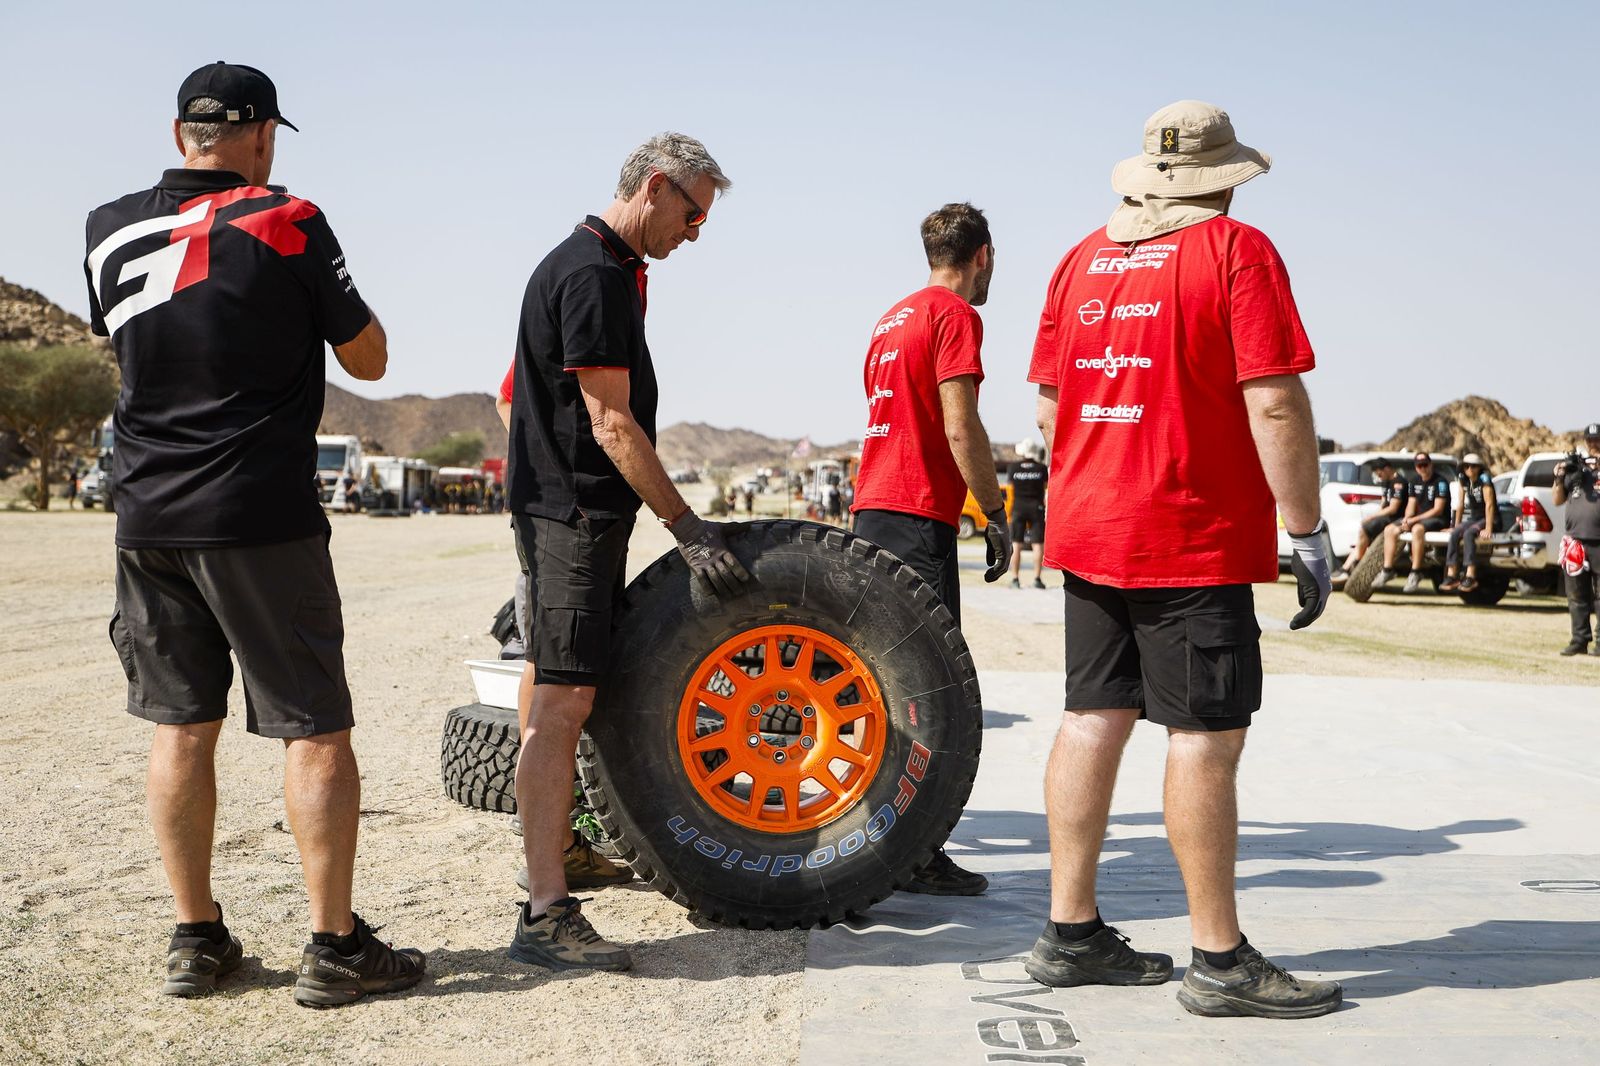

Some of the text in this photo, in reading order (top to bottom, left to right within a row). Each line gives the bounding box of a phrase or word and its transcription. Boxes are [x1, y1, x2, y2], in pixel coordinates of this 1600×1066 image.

[1134, 244, 1178, 254] TOYOTA
[1088, 256, 1128, 273] GR
[1111, 301, 1162, 321] repsol
[666, 740, 932, 877] BFGoodrich
